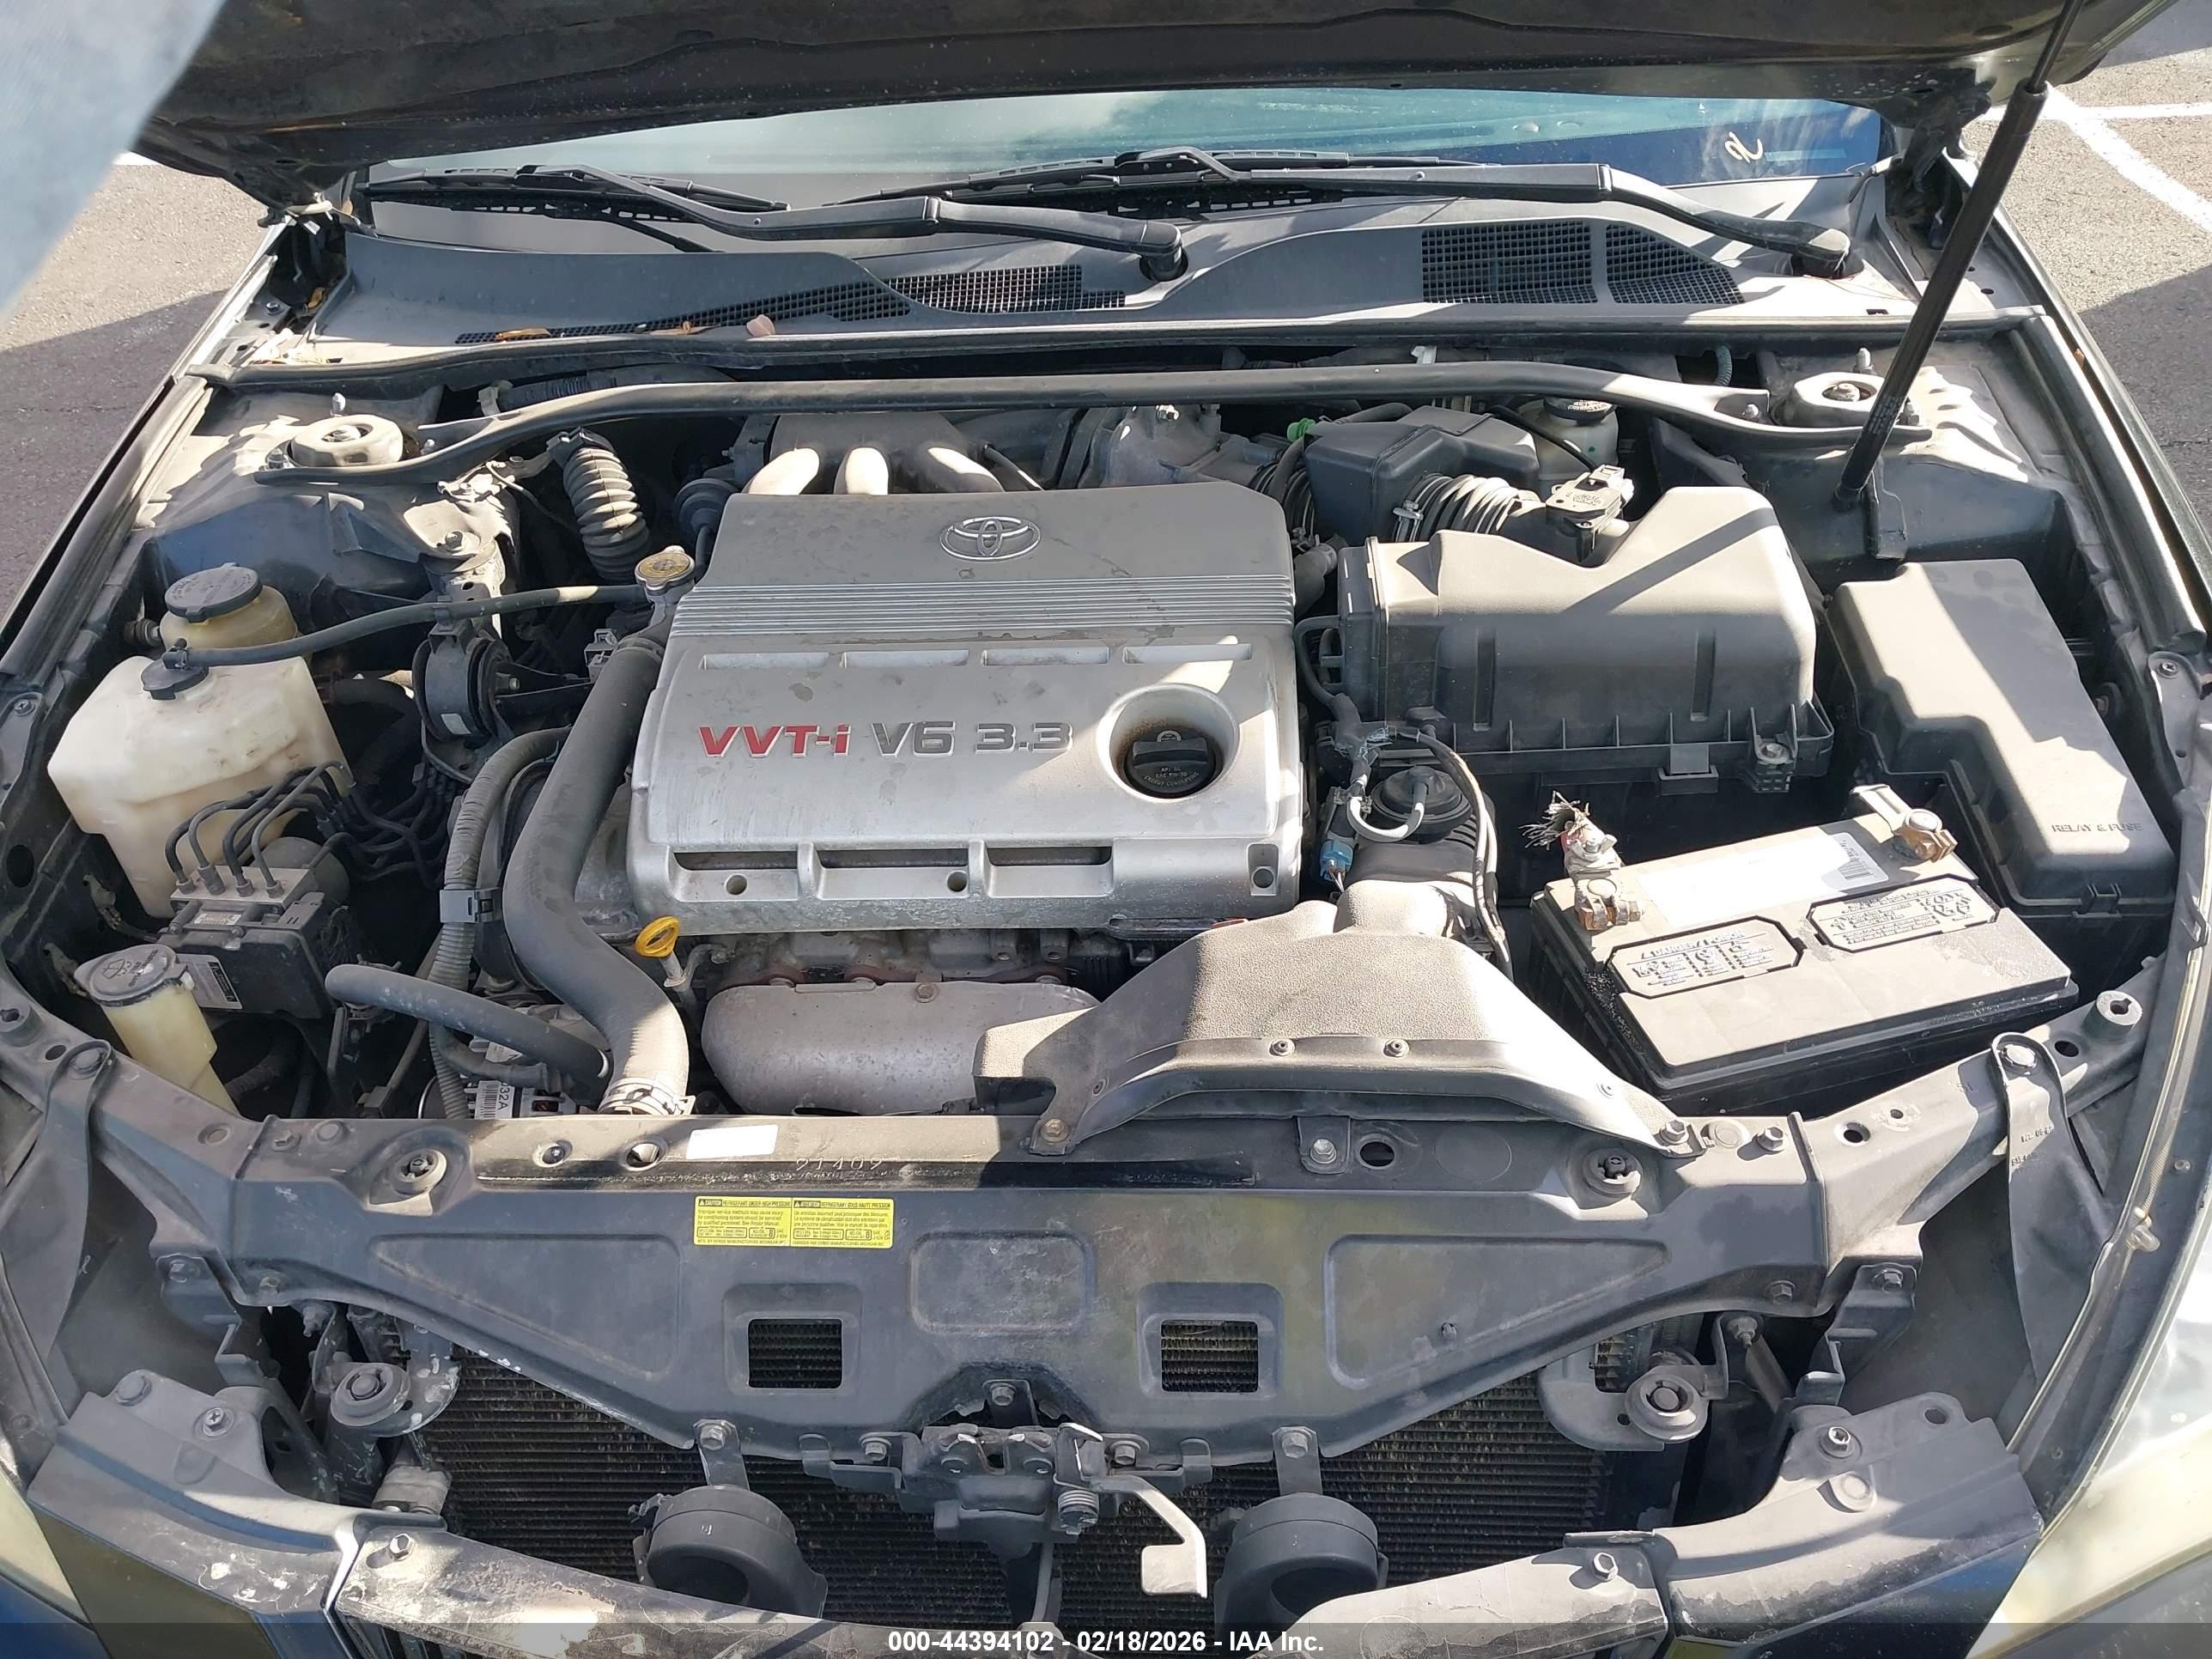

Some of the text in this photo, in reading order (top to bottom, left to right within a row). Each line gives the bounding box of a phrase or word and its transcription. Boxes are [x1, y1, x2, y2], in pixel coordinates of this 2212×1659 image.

[698, 720, 1073, 757] VVT-i V6 3.3
[2109, 823, 2143, 831] FUSE
[769, 1229, 773, 1237] 8
[866, 1231, 870, 1239] 8
